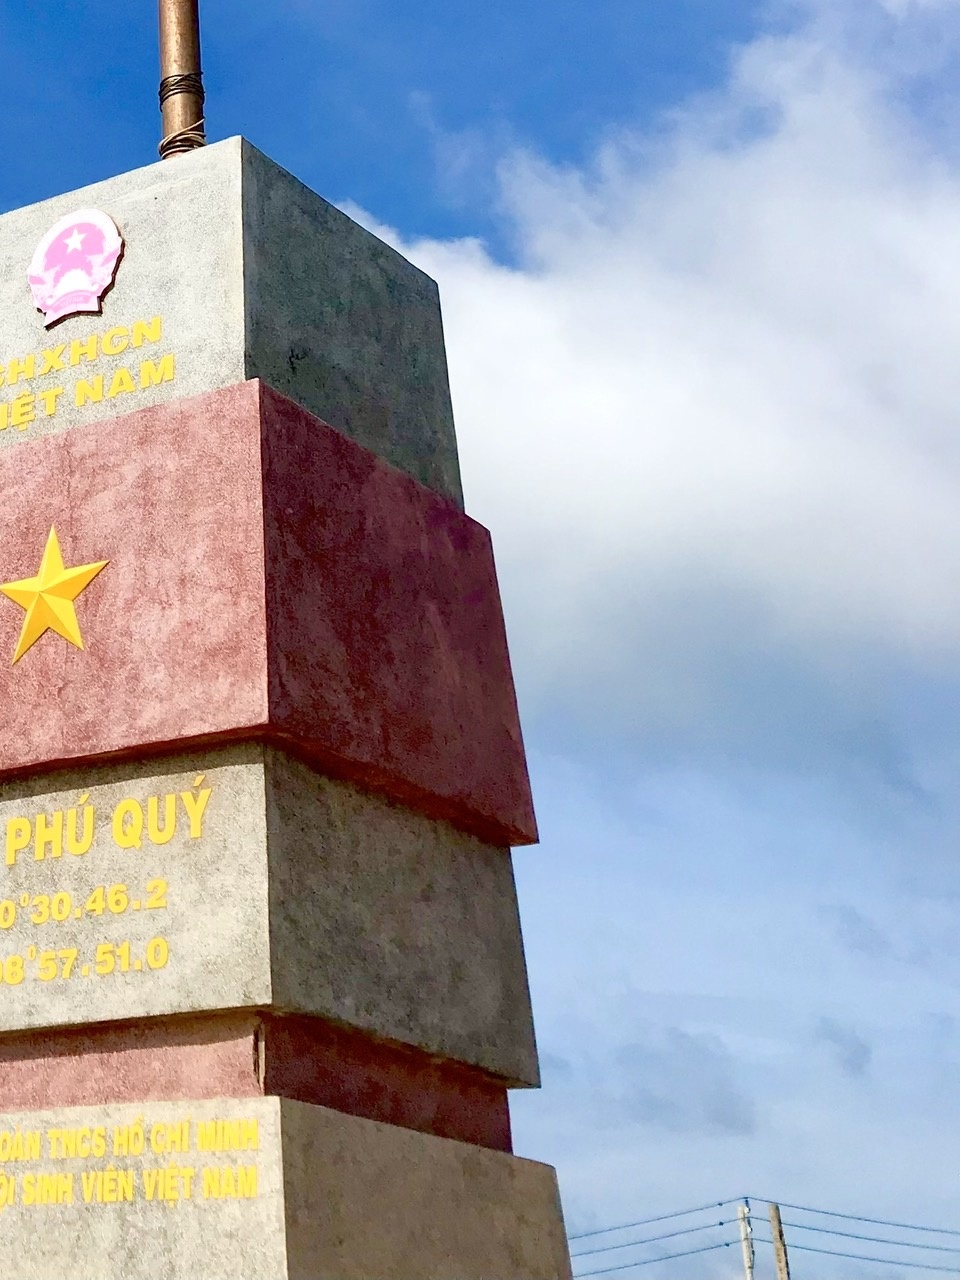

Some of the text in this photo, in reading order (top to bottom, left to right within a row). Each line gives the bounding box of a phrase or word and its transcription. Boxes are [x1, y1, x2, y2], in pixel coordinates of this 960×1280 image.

[74, 353, 176, 407] NAM
[5, 793, 95, 865] PHÚ
[111, 775, 213, 849] QUÝ
[47, 1126, 107, 1159] TNCS
[150, 1116, 191, 1154] CHÍ
[197, 1118, 259, 1152] MINH
[21, 1173, 74, 1206] SINH
[81, 1164, 135, 1203] VIÊN
[142, 1161, 195, 1208] VIỆT
[202, 1165, 258, 1199] NAM
